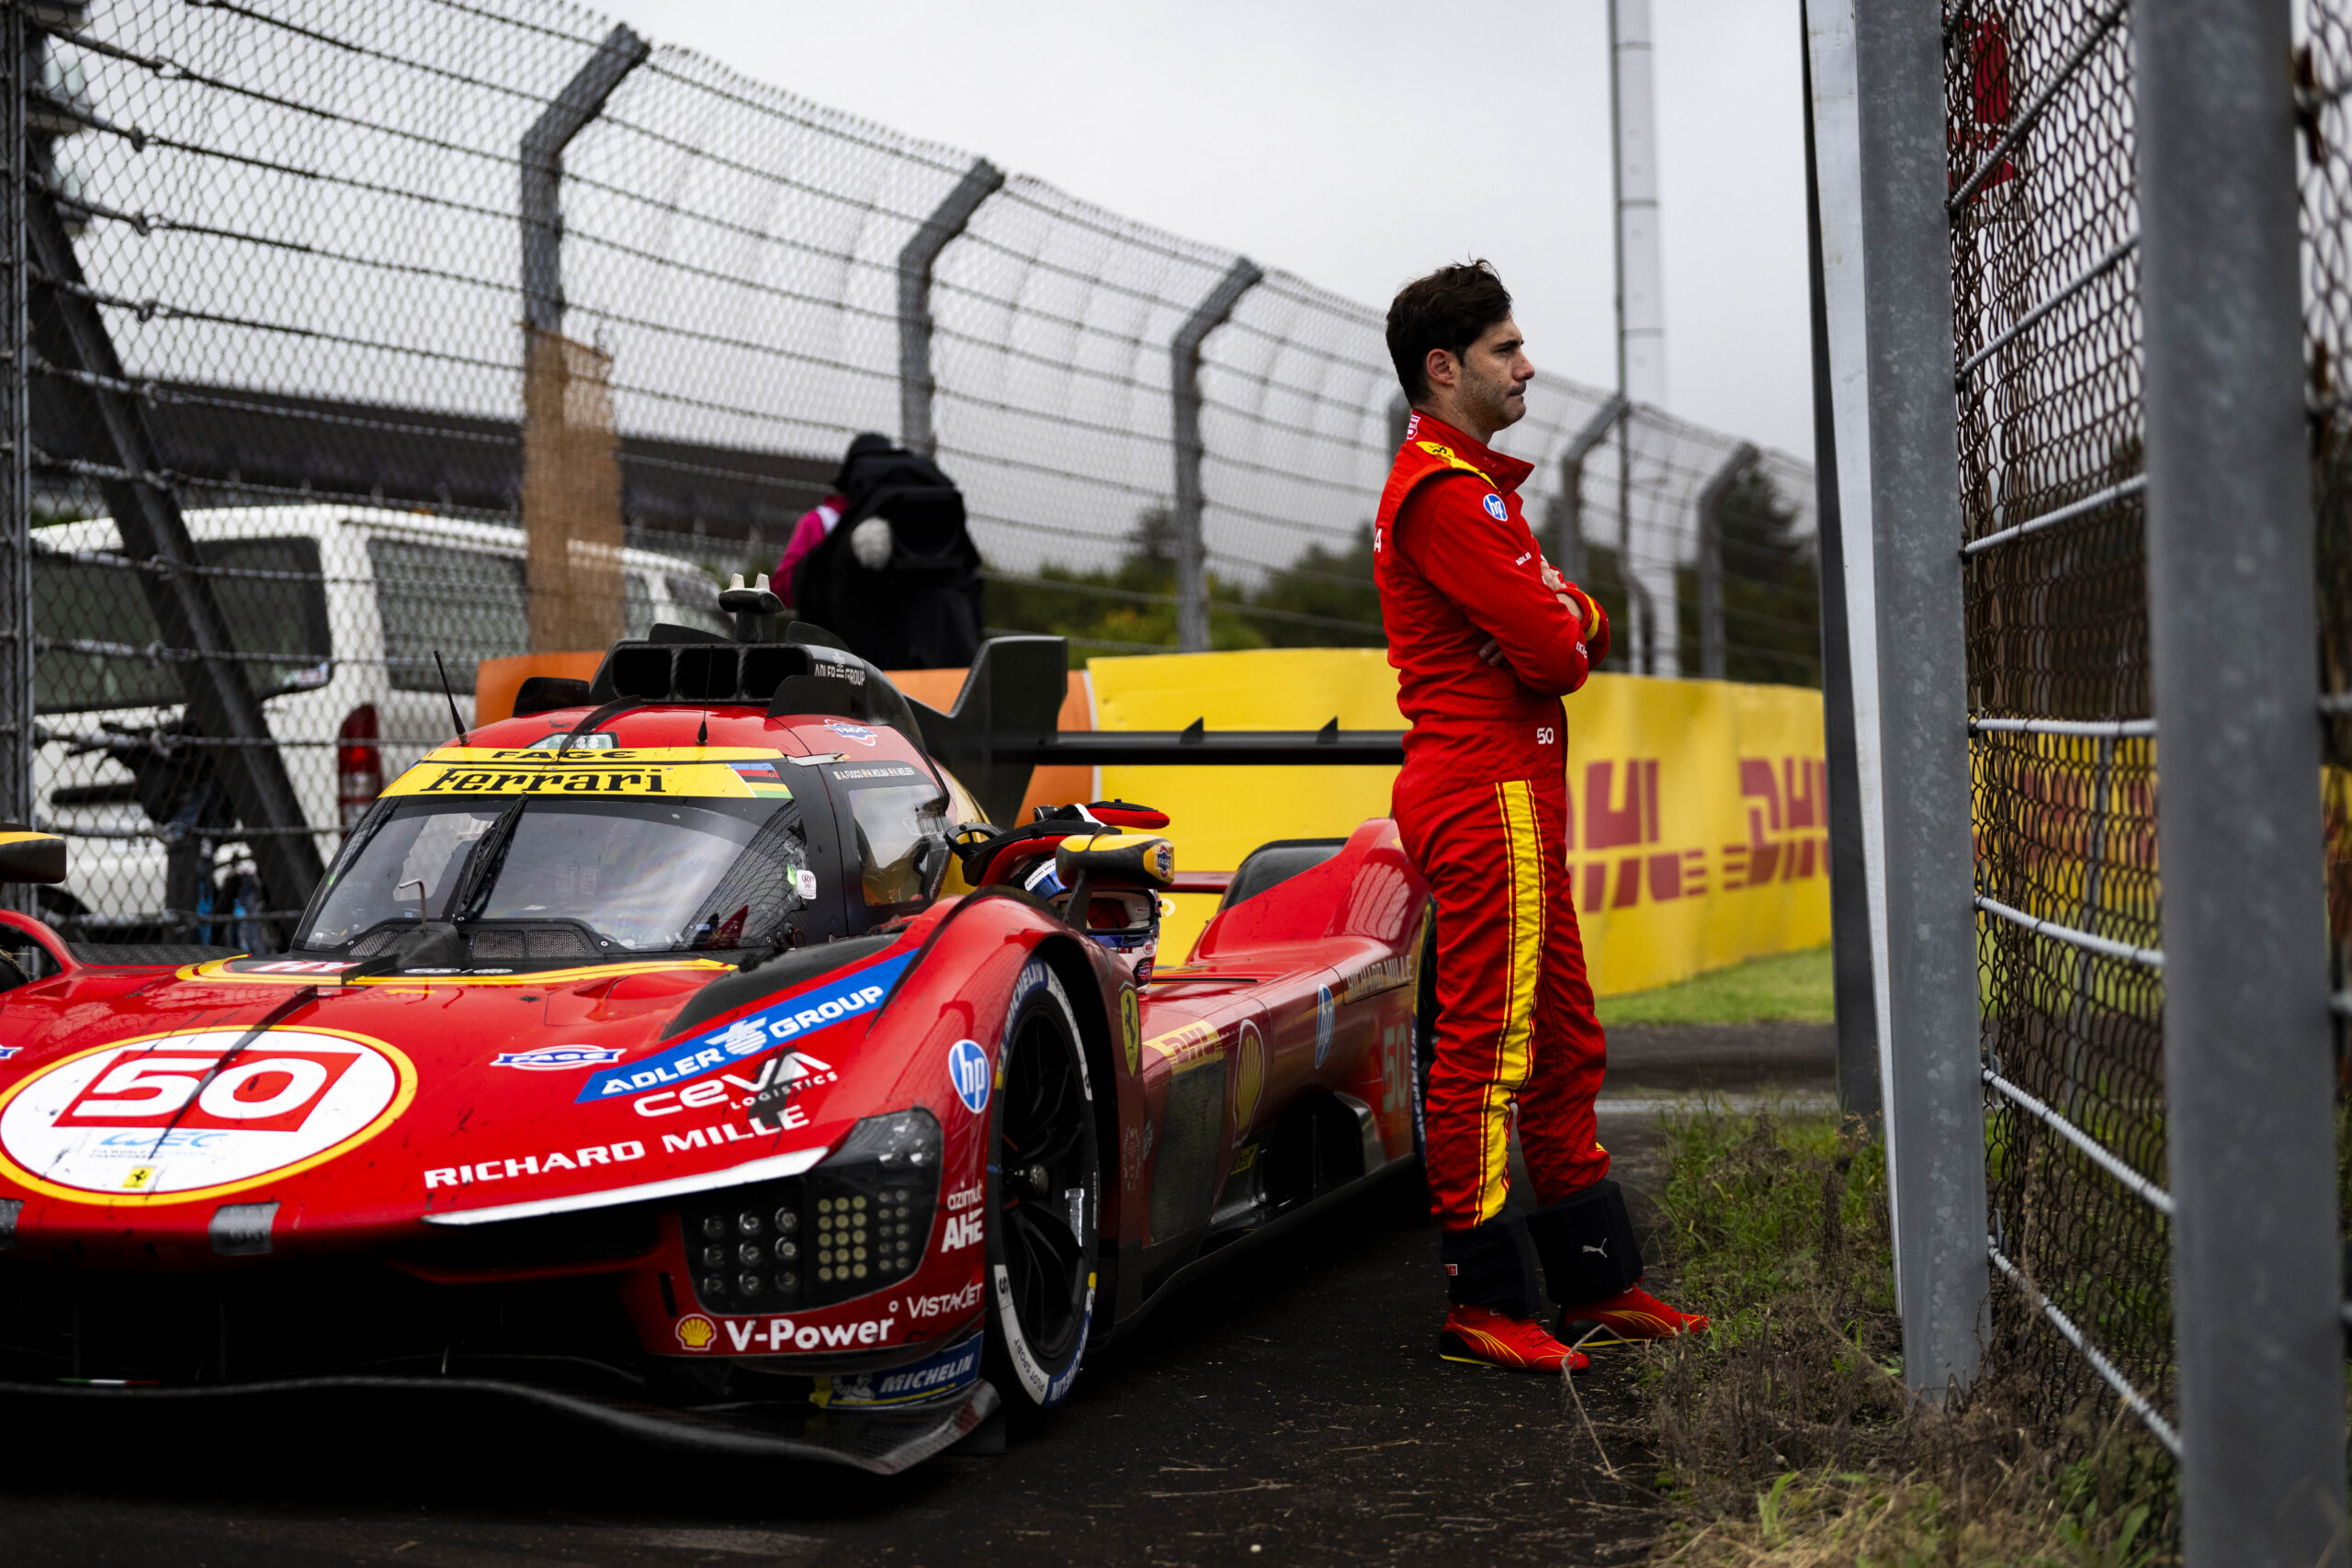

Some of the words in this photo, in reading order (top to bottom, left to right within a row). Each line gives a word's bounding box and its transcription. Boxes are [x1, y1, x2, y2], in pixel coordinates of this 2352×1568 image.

[1484, 494, 1508, 521] hp
[844, 668, 865, 686] GROUP
[1536, 727, 1555, 745] 50
[491, 750, 639, 760] FAGE
[420, 768, 667, 794] Ferrari
[1346, 963, 1383, 999] RICHARD
[1384, 954, 1413, 987] MILLE
[511, 1051, 609, 1063] FAGE
[601, 1046, 726, 1095] ADLER
[768, 985, 884, 1039] GROUP
[1161, 1027, 1216, 1065] DHL
[955, 1043, 986, 1112] hp
[1382, 1021, 1409, 1113] 50
[72, 1056, 328, 1120] 50
[729, 1070, 839, 1111] LOGISTICS
[99, 1131, 230, 1147] WEC
[424, 1140, 646, 1189] RICHARD
[662, 1104, 810, 1154] MILLE
[947, 1179, 983, 1212] azimut
[724, 1317, 895, 1352] V-Power
[1013, 1337, 1032, 1372] SPORT
[879, 1352, 976, 1394] MICHELIN
[1029, 1371, 1045, 1393] PILOT
